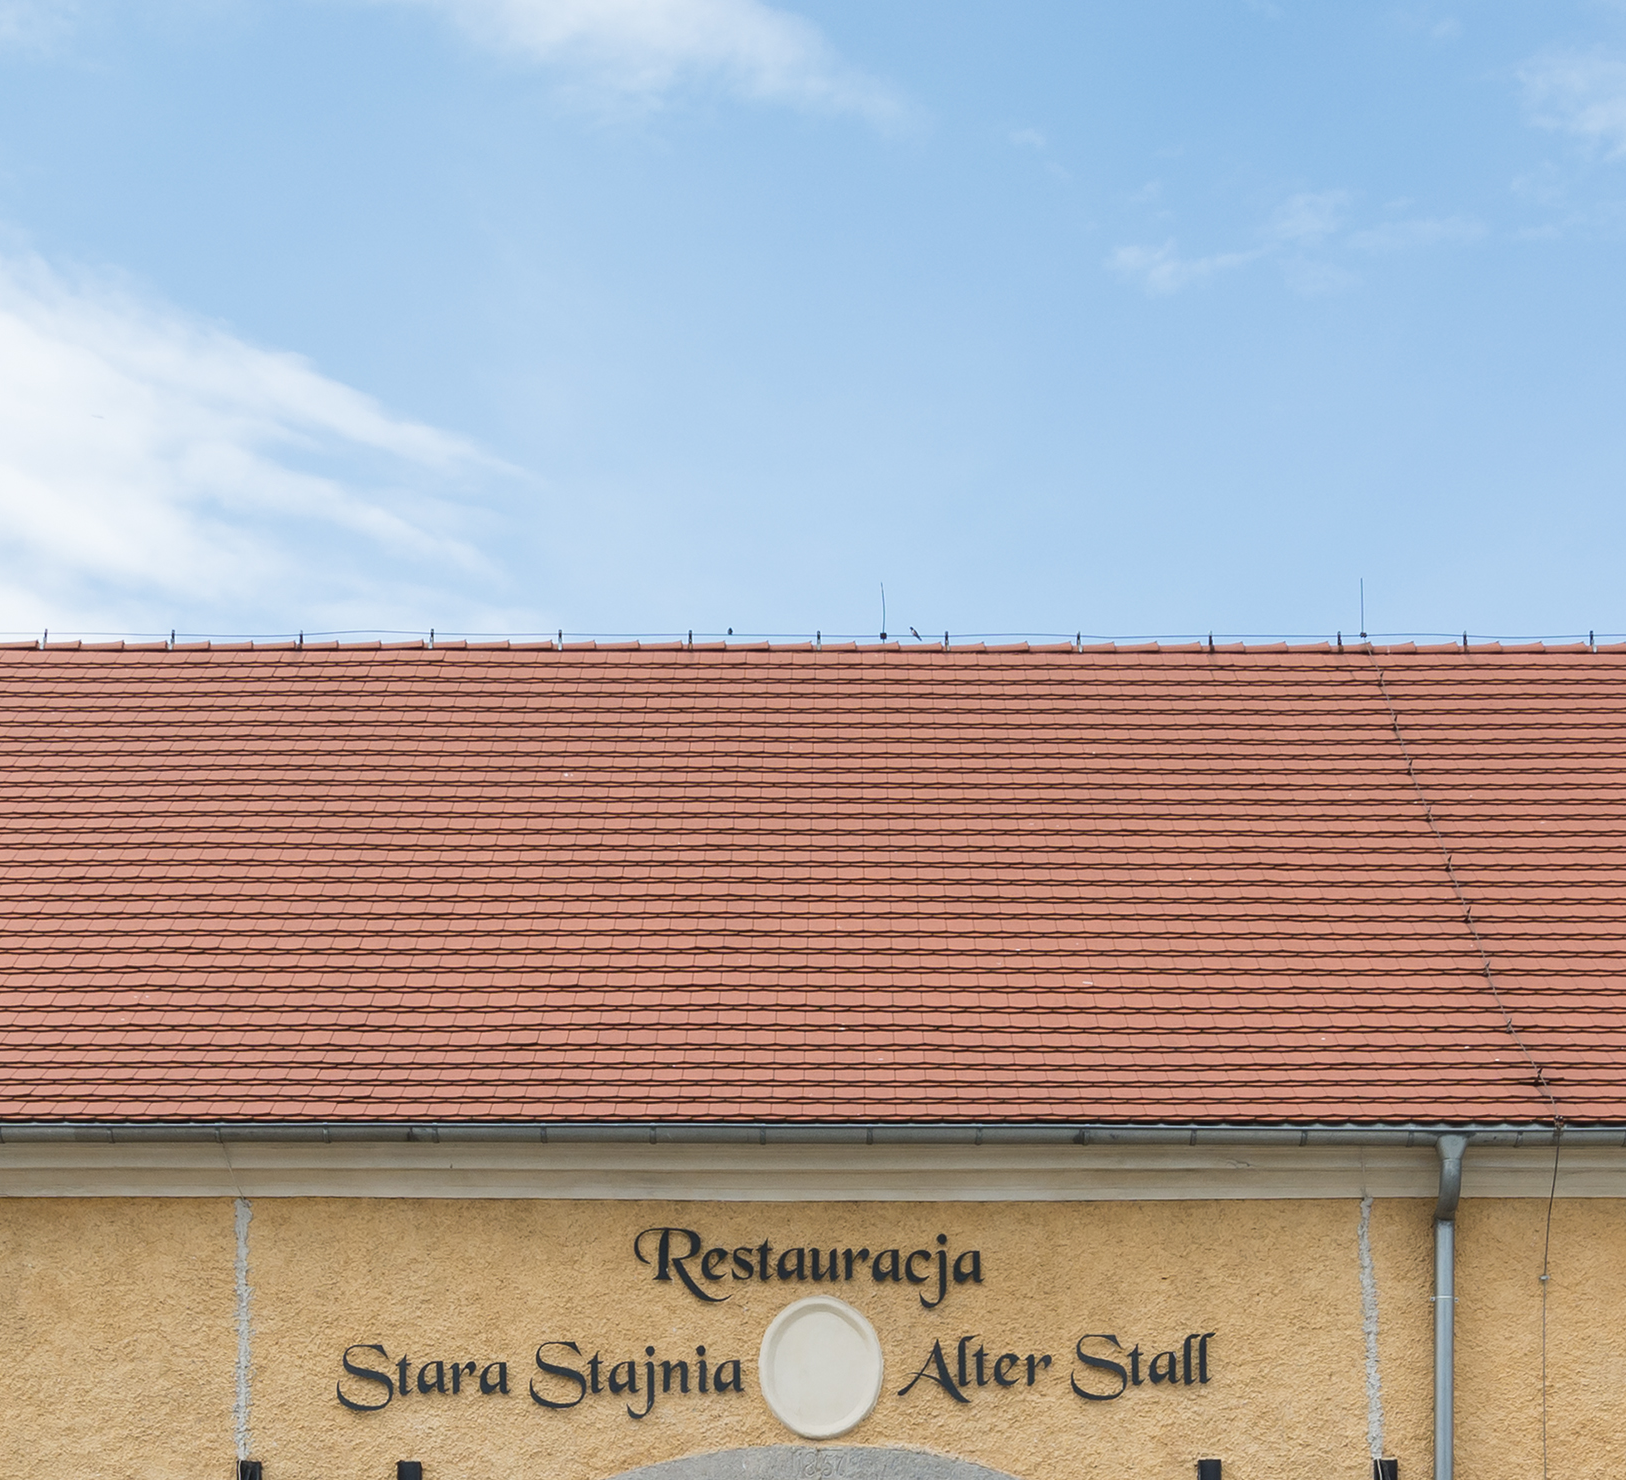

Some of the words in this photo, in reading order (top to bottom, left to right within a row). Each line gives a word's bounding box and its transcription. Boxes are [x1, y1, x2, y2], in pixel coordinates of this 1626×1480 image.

[633, 1227, 985, 1309] Restauracja
[336, 1344, 511, 1412] Stara
[529, 1341, 745, 1420] Stajnia
[897, 1334, 1052, 1403] Alter
[1070, 1332, 1216, 1401] Stall
[792, 1451, 847, 1478] 1857
